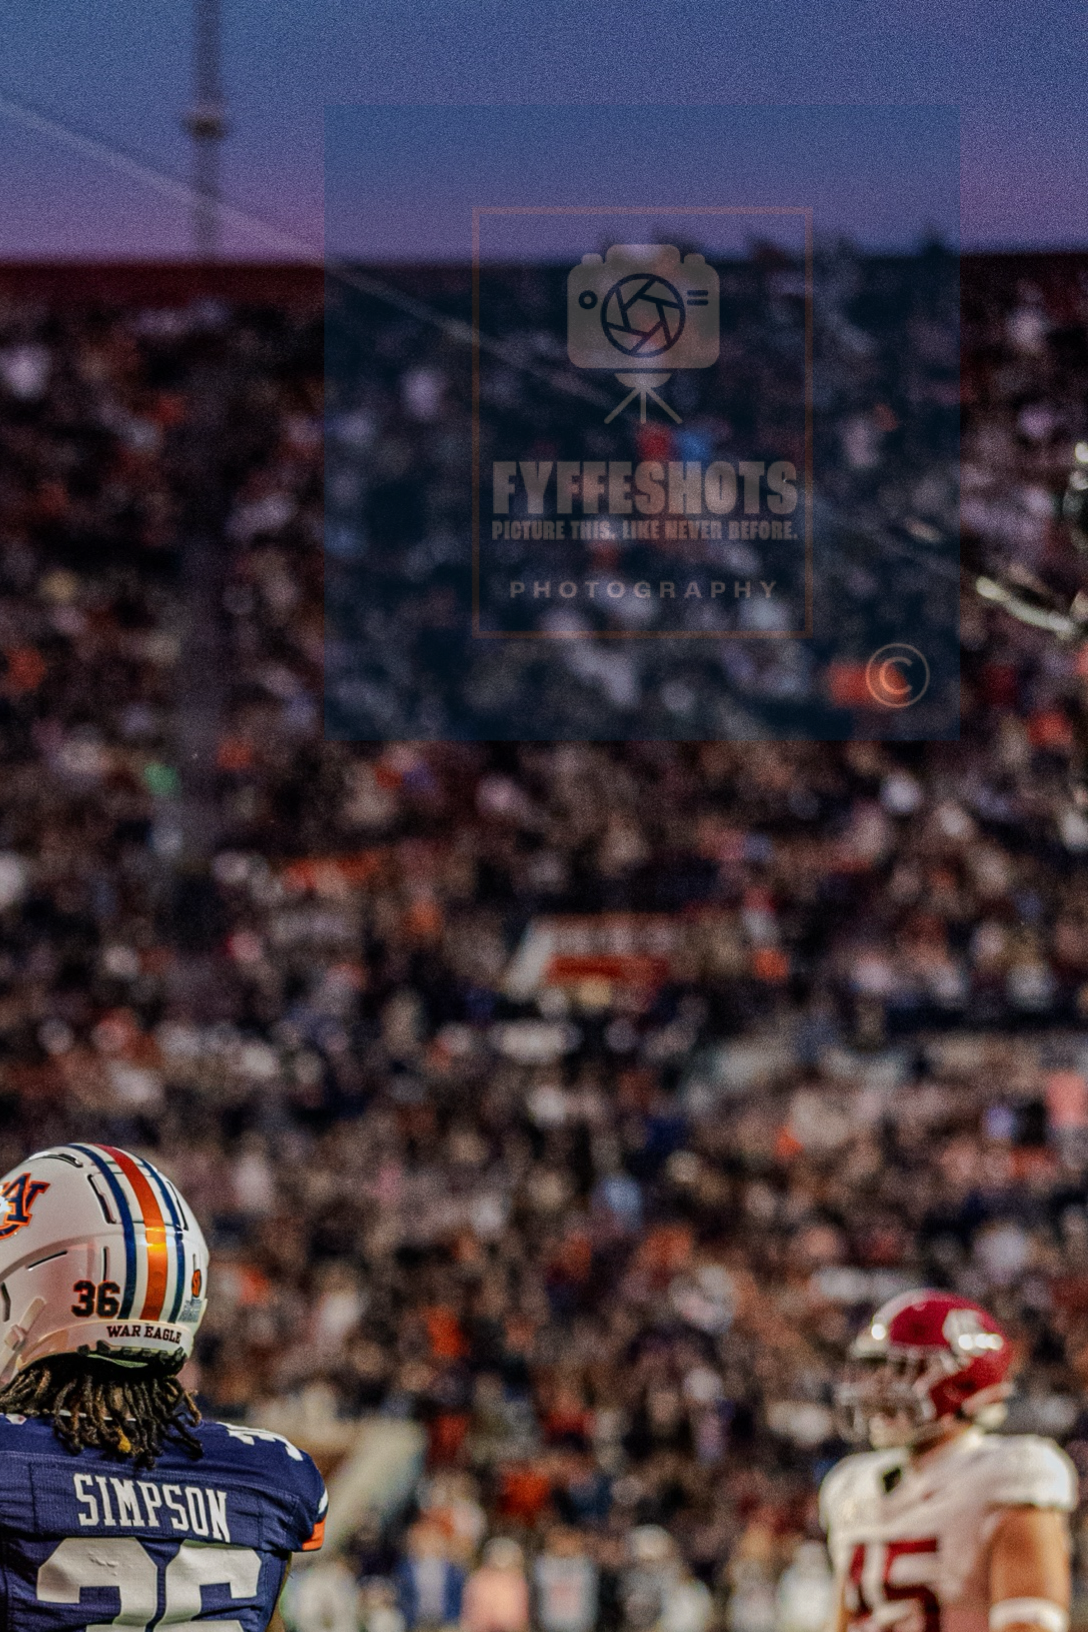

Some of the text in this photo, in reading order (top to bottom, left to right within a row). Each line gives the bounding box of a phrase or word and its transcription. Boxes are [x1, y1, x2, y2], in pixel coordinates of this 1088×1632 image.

[71, 1280, 120, 1318] 36
[107, 1325, 182, 1344] WAR EAGLE
[73, 1472, 231, 1543] SIMPSON
